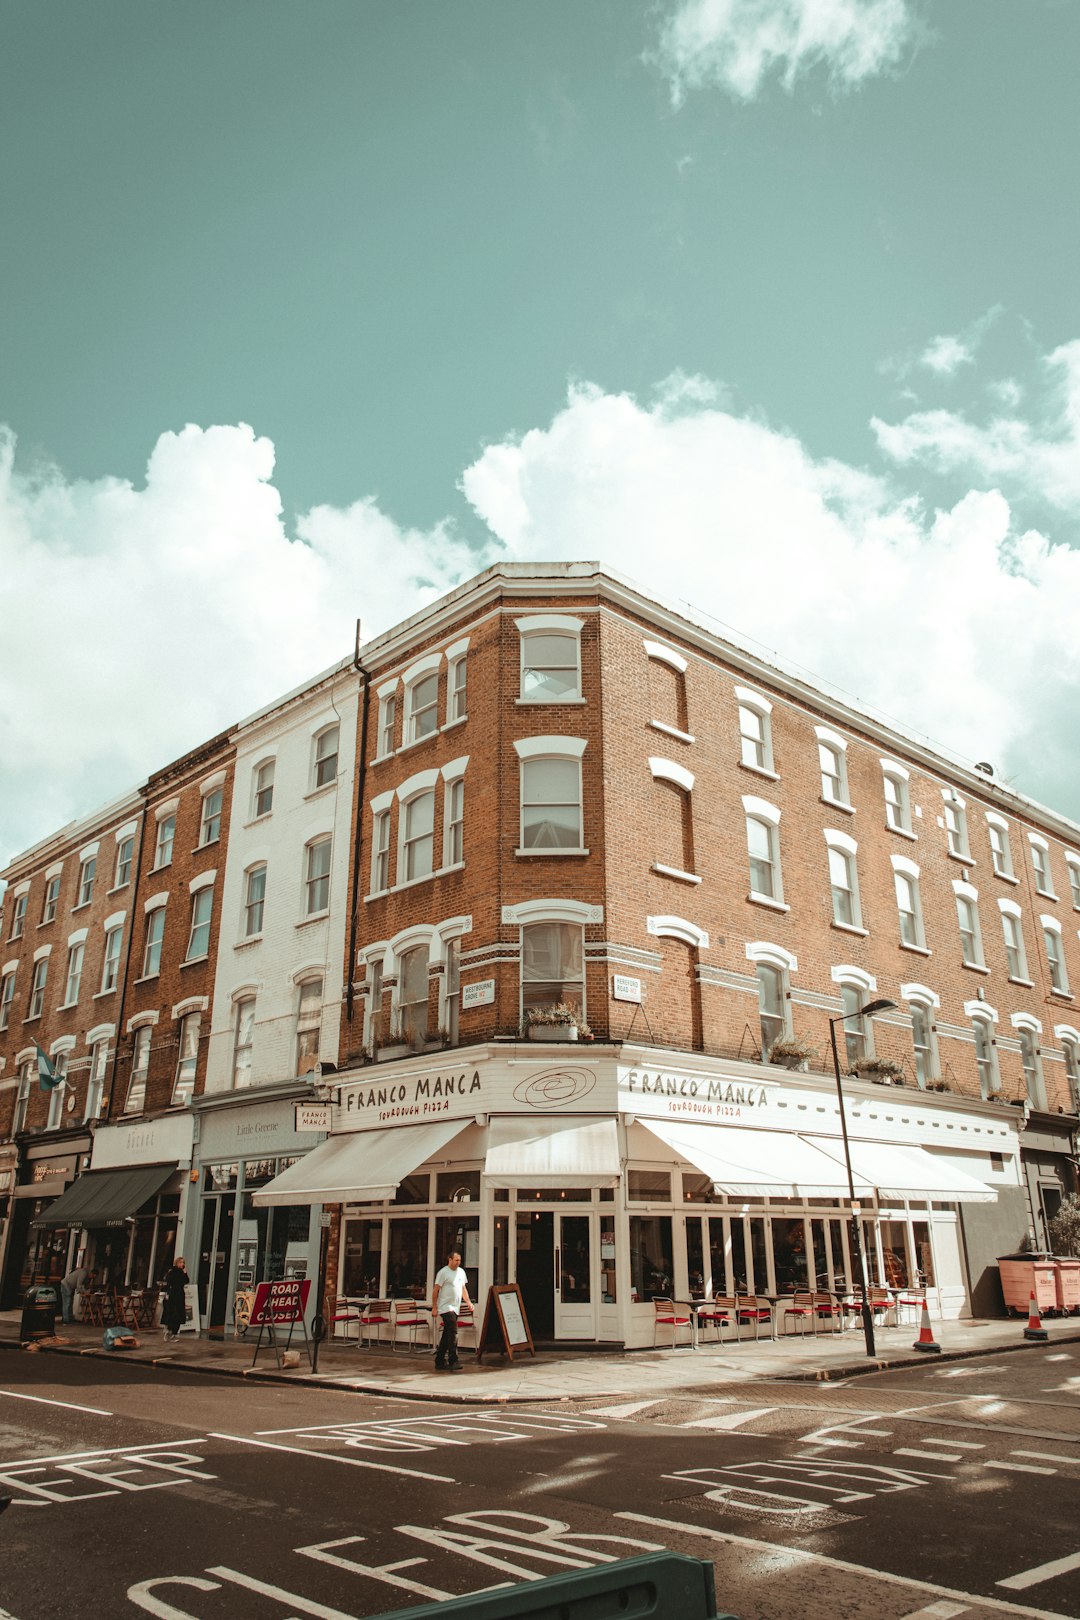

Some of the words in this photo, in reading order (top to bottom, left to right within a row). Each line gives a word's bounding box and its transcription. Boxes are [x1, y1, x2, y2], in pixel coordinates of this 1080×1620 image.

[465, 981, 493, 993] WESTBOURNE
[617, 977, 638, 988] HEREFORD
[617, 984, 628, 993] ROAD
[465, 992, 478, 1001] GROVE
[347, 1084, 406, 1112] FRANCO
[415, 1070, 481, 1102] MANCA
[628, 1072, 698, 1097] FRANCO
[707, 1080, 767, 1107] MANCA
[302, 1111, 327, 1119] FRANCO
[379, 1105, 419, 1121] SOURDOUGH
[423, 1100, 449, 1113] PIZZA
[668, 1101, 712, 1115] SOURDOUGH
[716, 1105, 741, 1117] PIZZA
[237, 1123, 254, 1136] Little
[255, 1122, 279, 1133] Greene
[270, 1284, 299, 1295] ROAD
[263, 1296, 299, 1308] AHEAD
[256, 1310, 299, 1322] CLOSED
